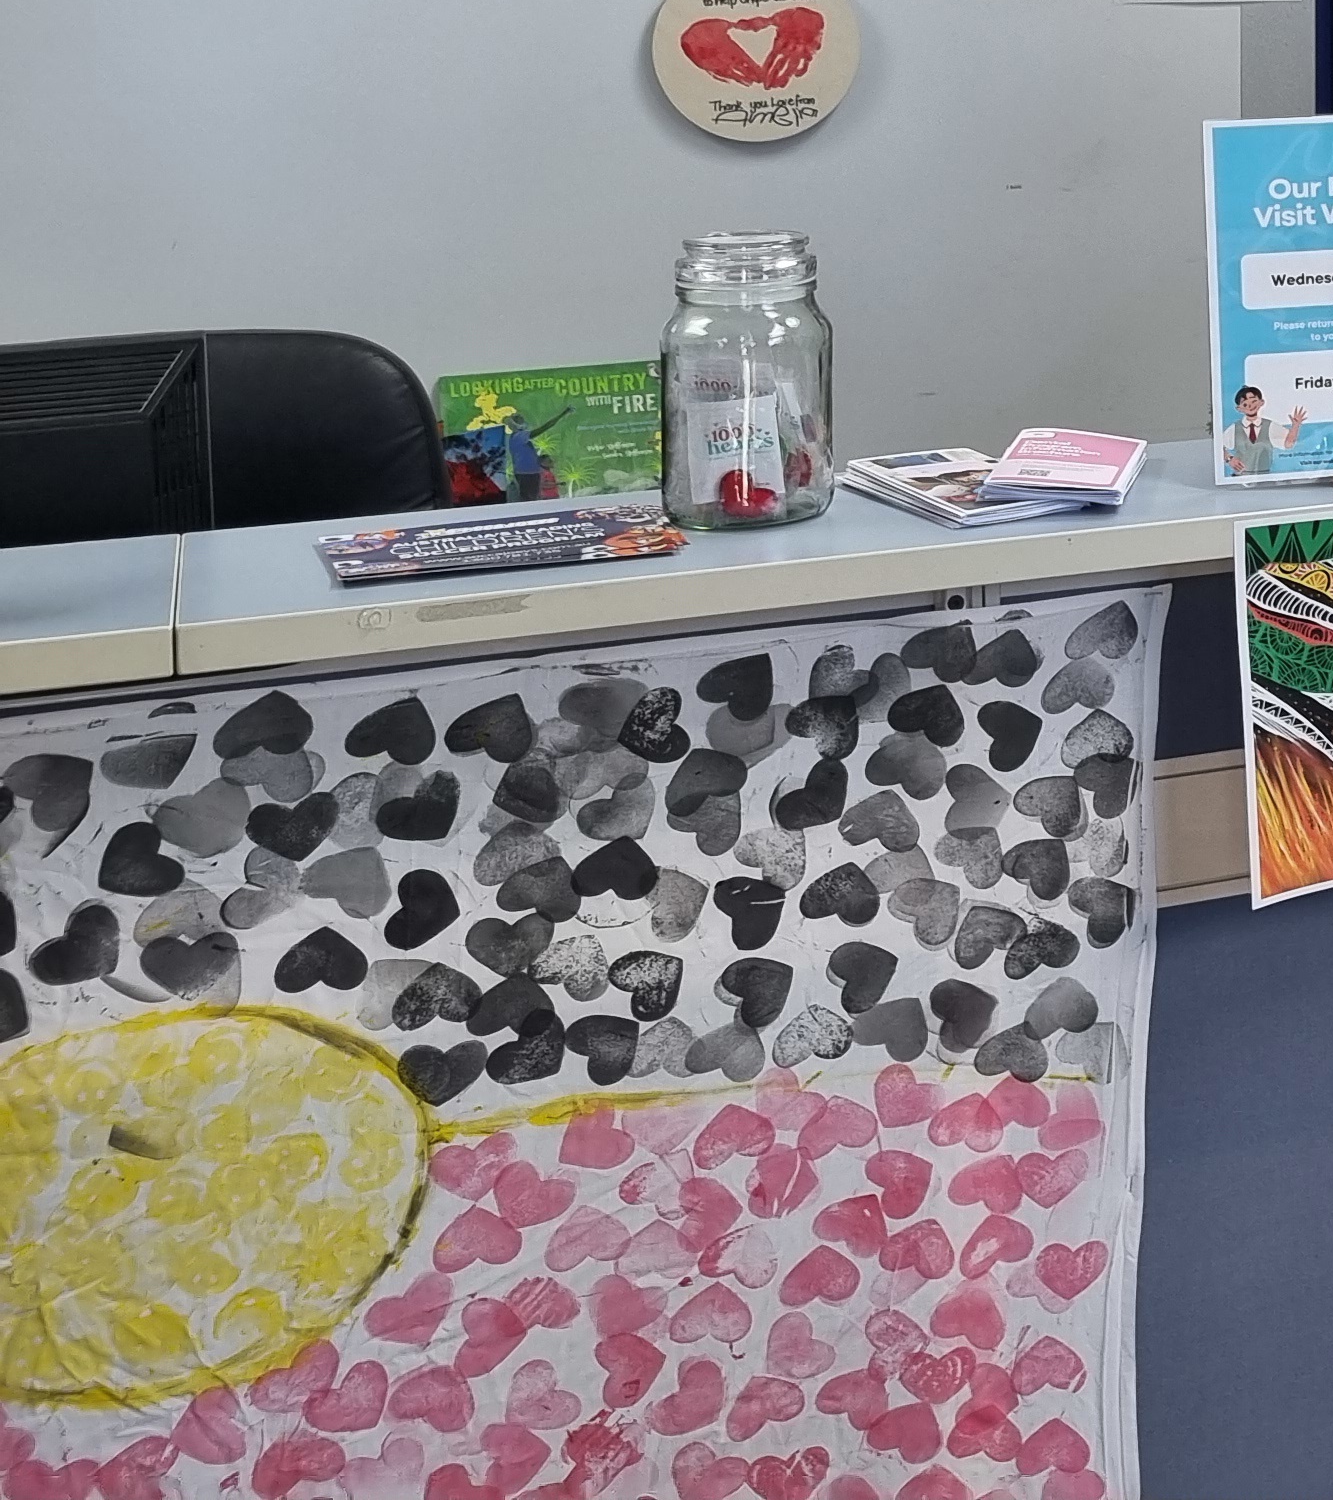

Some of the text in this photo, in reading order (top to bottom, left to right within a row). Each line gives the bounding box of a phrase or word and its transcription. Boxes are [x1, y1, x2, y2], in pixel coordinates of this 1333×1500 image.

[710, 101, 743, 112] Thank
[750, 99, 768, 110] you
[795, 95, 815, 105] from
[1269, 178, 1321, 200] Our
[1254, 203, 1316, 228] Visit
[1274, 321, 1305, 330] Please
[450, 372, 646, 398] LOOKING AFTER COUNTRY
[586, 393, 656, 414] WITH FIRE
